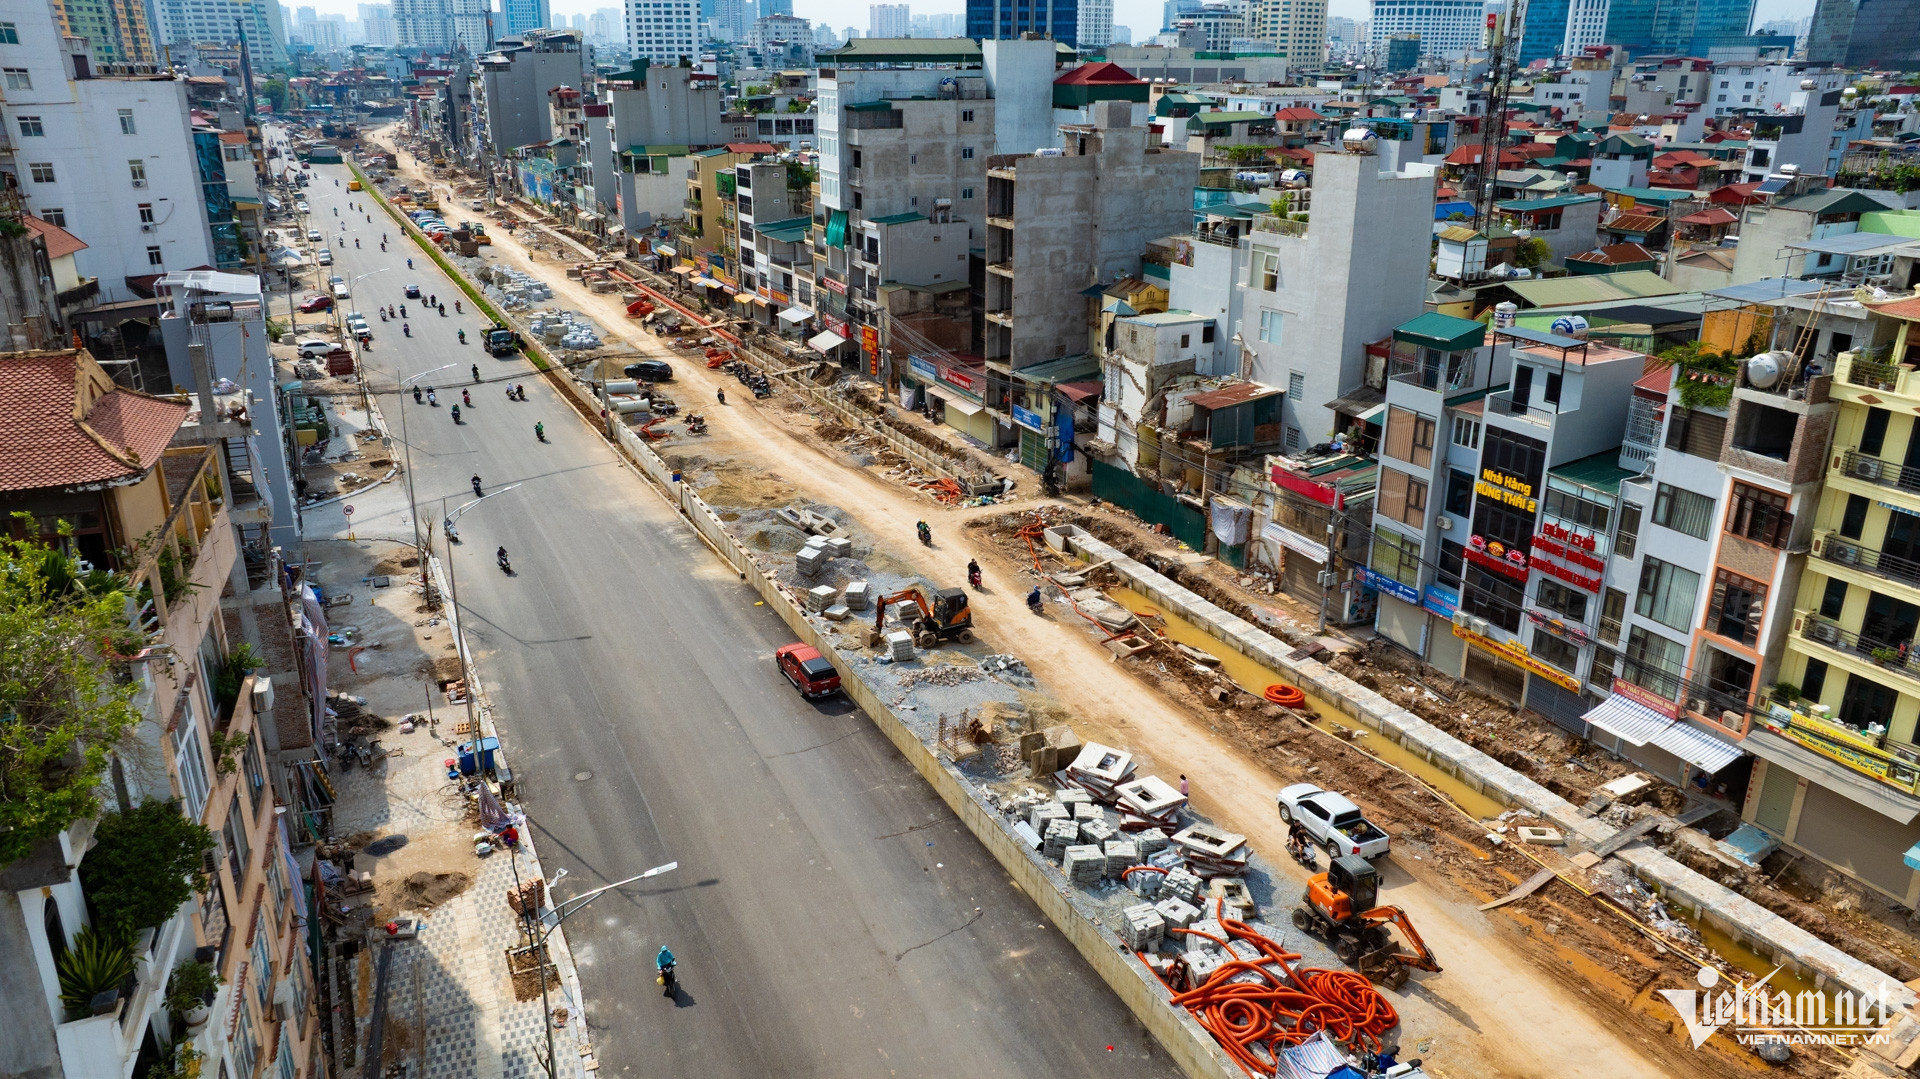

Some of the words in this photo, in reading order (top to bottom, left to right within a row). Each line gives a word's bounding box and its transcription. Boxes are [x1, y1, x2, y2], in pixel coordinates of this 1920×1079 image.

[1483, 468, 1503, 485] Nhà
[1504, 476, 1531, 497] Hàng
[1503, 492, 1526, 509] THÁI
[1527, 500, 1536, 512] 2
